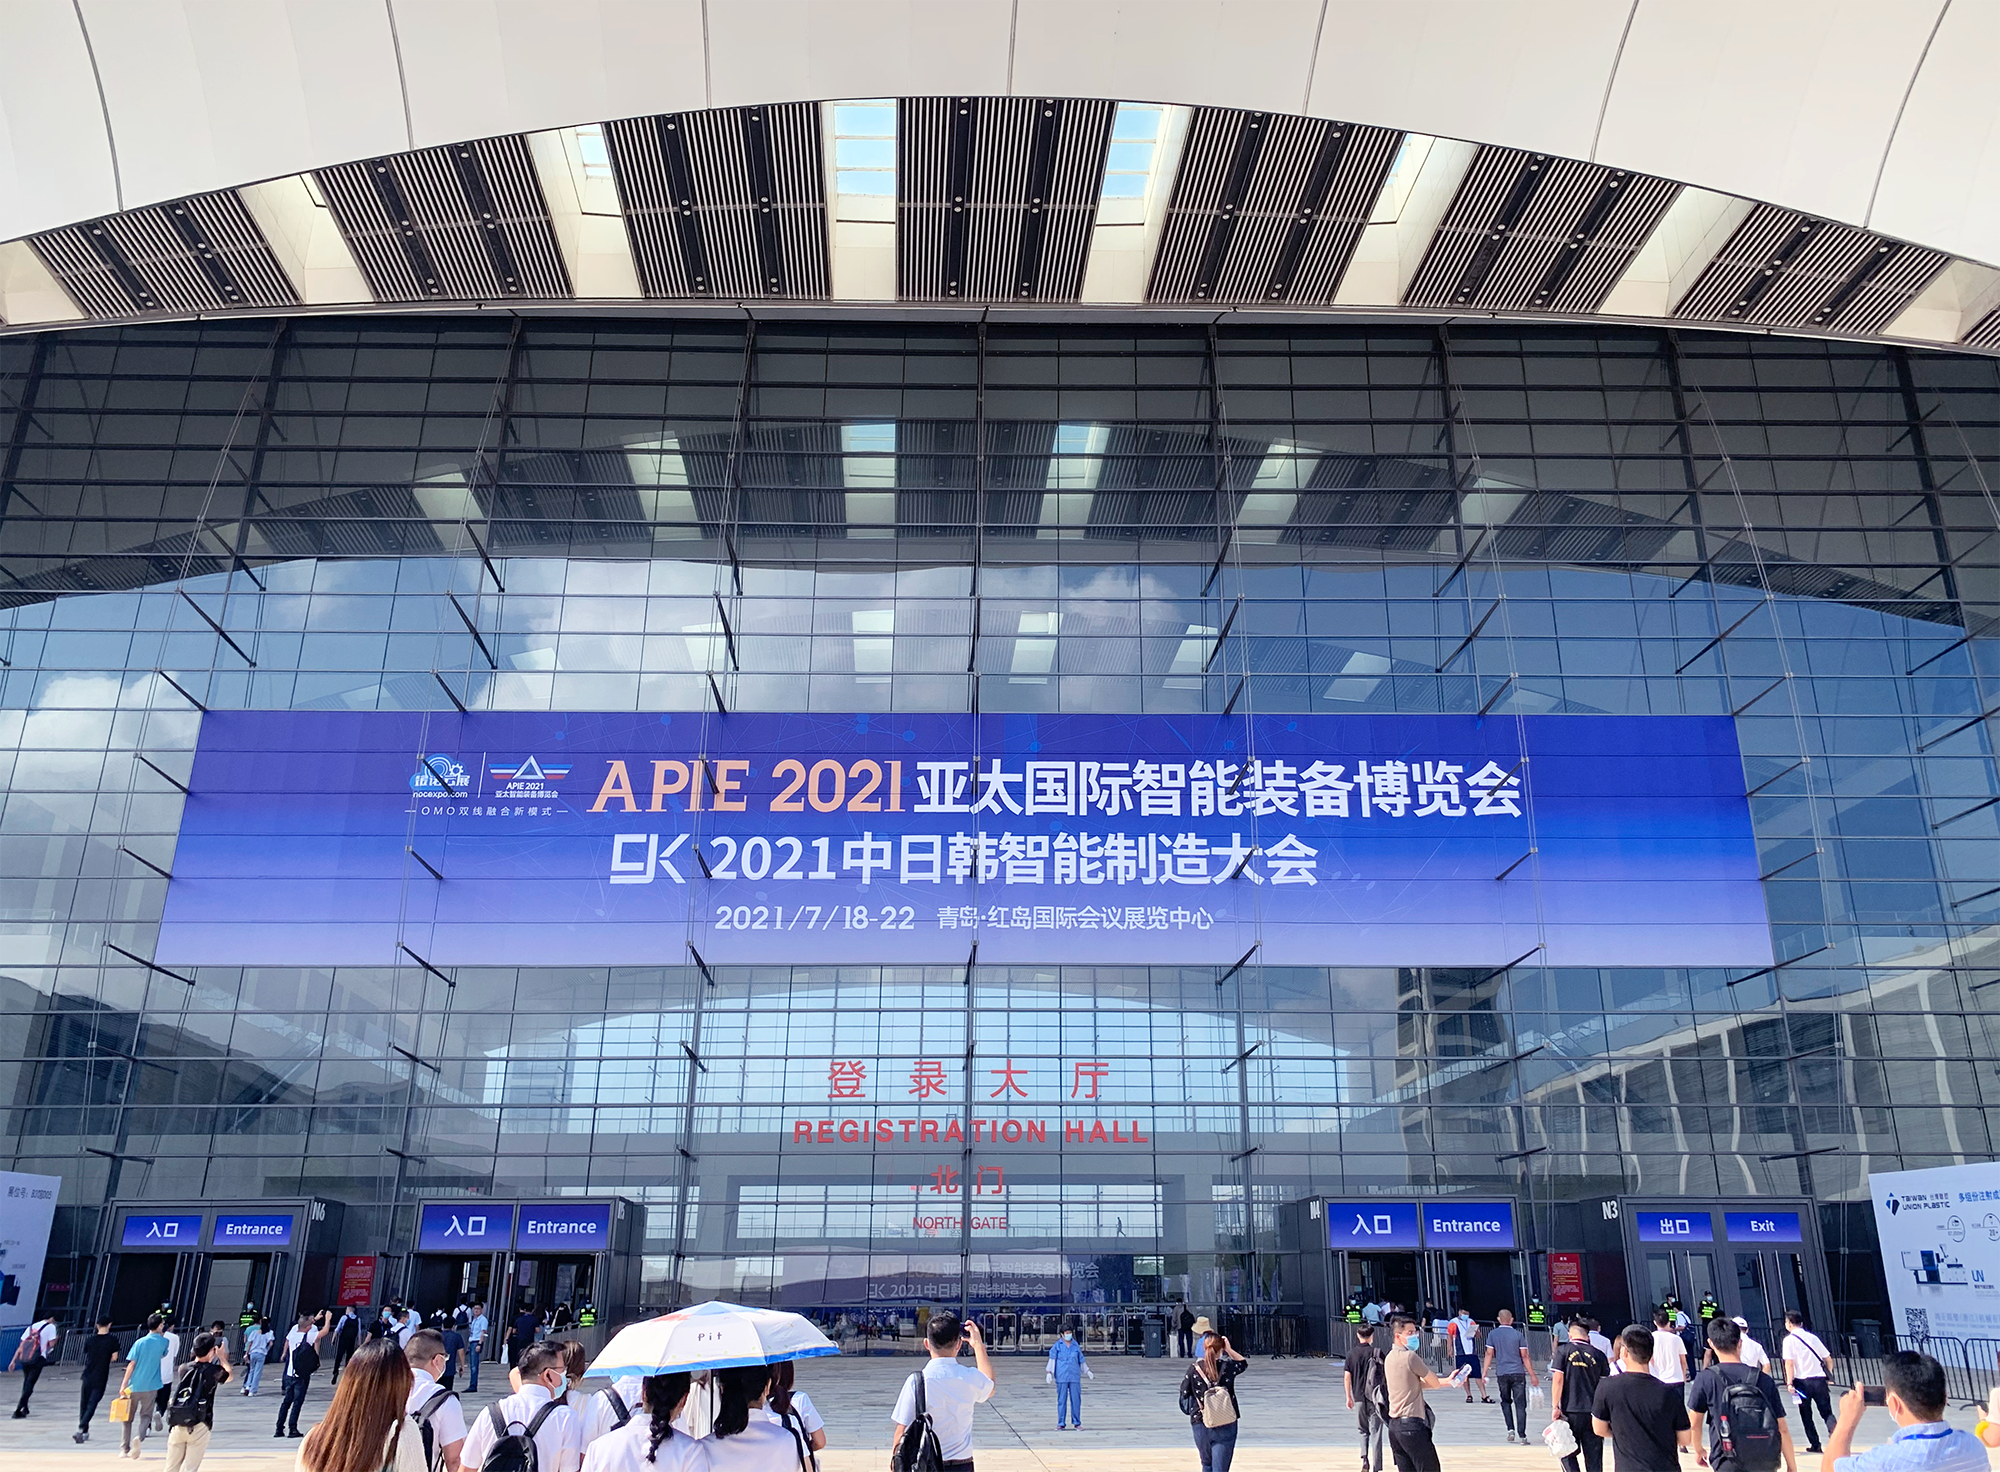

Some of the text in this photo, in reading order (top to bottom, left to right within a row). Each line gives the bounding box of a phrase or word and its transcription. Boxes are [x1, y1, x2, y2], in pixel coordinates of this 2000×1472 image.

[506, 782, 545, 790] APIE 2021
[586, 758, 1523, 818] APIE 2021 亚太国际智能装备博览会
[714, 904, 915, 931] 2021/7/18-22
[793, 1119, 1149, 1144] REGISTRATION HALL
[930, 1164, 1004, 1195] 北门
[311, 1201, 326, 1222] N6
[1601, 1200, 1619, 1220] N3
[1902, 1202, 1922, 1210] UNION
[145, 1221, 179, 1238] 入口
[225, 1223, 284, 1236] Entrance
[443, 1214, 487, 1237] 入口
[527, 1220, 597, 1234] Entrance
[913, 1216, 1008, 1230] NORTH GATE
[1351, 1213, 1392, 1235] 入口
[1432, 1218, 1501, 1233] Entrance
[1659, 1218, 1690, 1235] 出口
[1750, 1219, 1776, 1233] Exit
